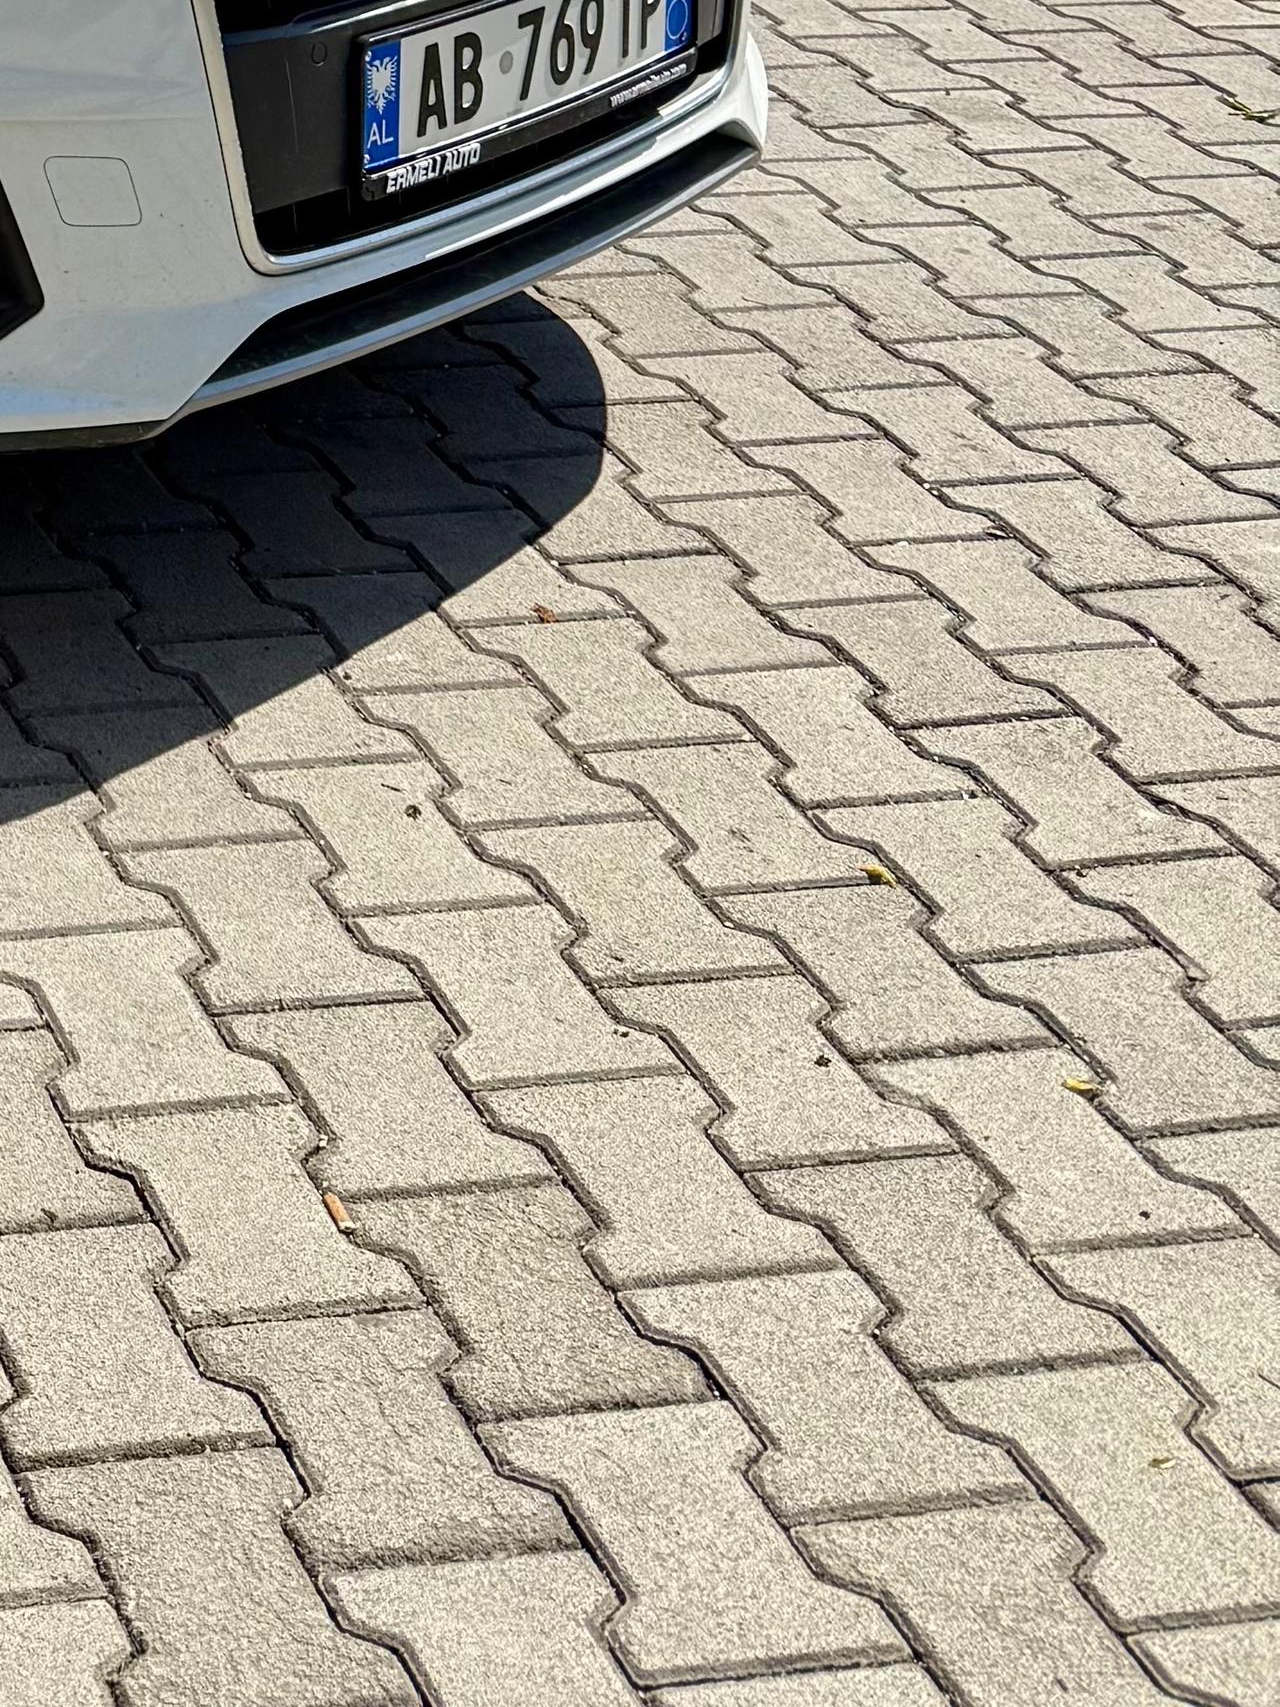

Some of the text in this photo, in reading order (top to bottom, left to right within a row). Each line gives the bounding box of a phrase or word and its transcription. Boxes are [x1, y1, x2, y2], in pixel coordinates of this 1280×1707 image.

[416, 31, 484, 138] AB
[366, 120, 395, 149] AL
[443, 142, 481, 175] AUTO
